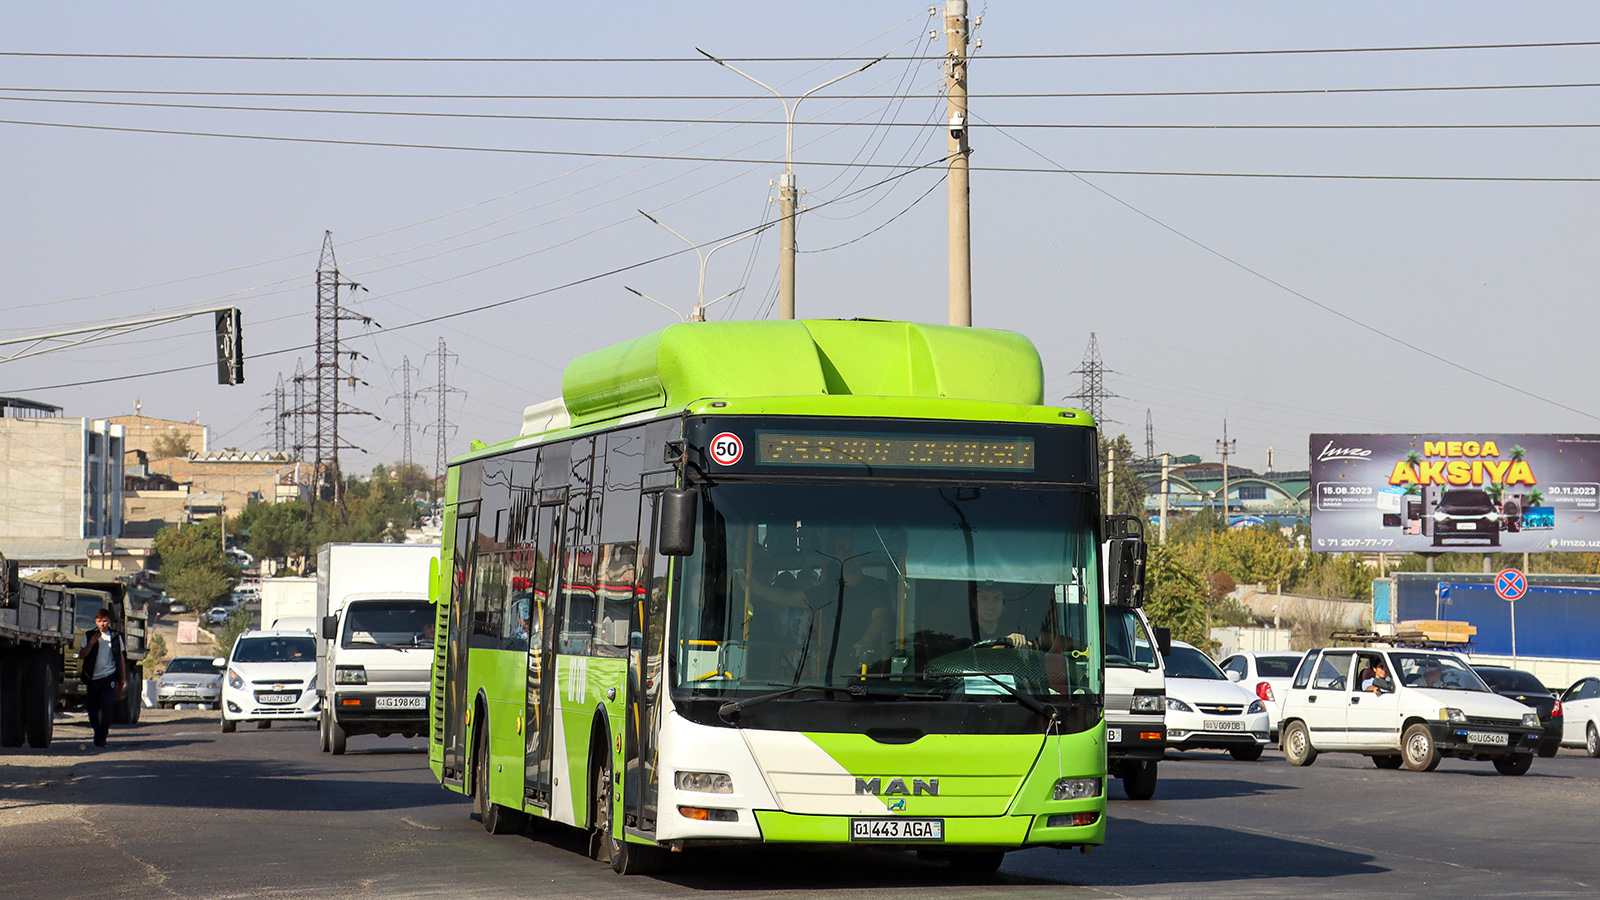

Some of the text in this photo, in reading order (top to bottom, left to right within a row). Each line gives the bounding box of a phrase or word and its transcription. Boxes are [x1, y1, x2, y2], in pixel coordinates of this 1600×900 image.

[716, 442, 737, 456] 50
[1423, 441, 1500, 457] MEGA
[1388, 460, 1537, 485] AKSIYA
[1323, 487, 1373, 495] 15.08.2023
[1548, 487, 1596, 495] 30.11.2023
[1327, 538, 1394, 547] 71 207-77-77
[855, 777, 940, 796] MAN
[855, 823, 869, 835] 01
[872, 821, 899, 837] 443
[903, 822, 933, 837] AGA
